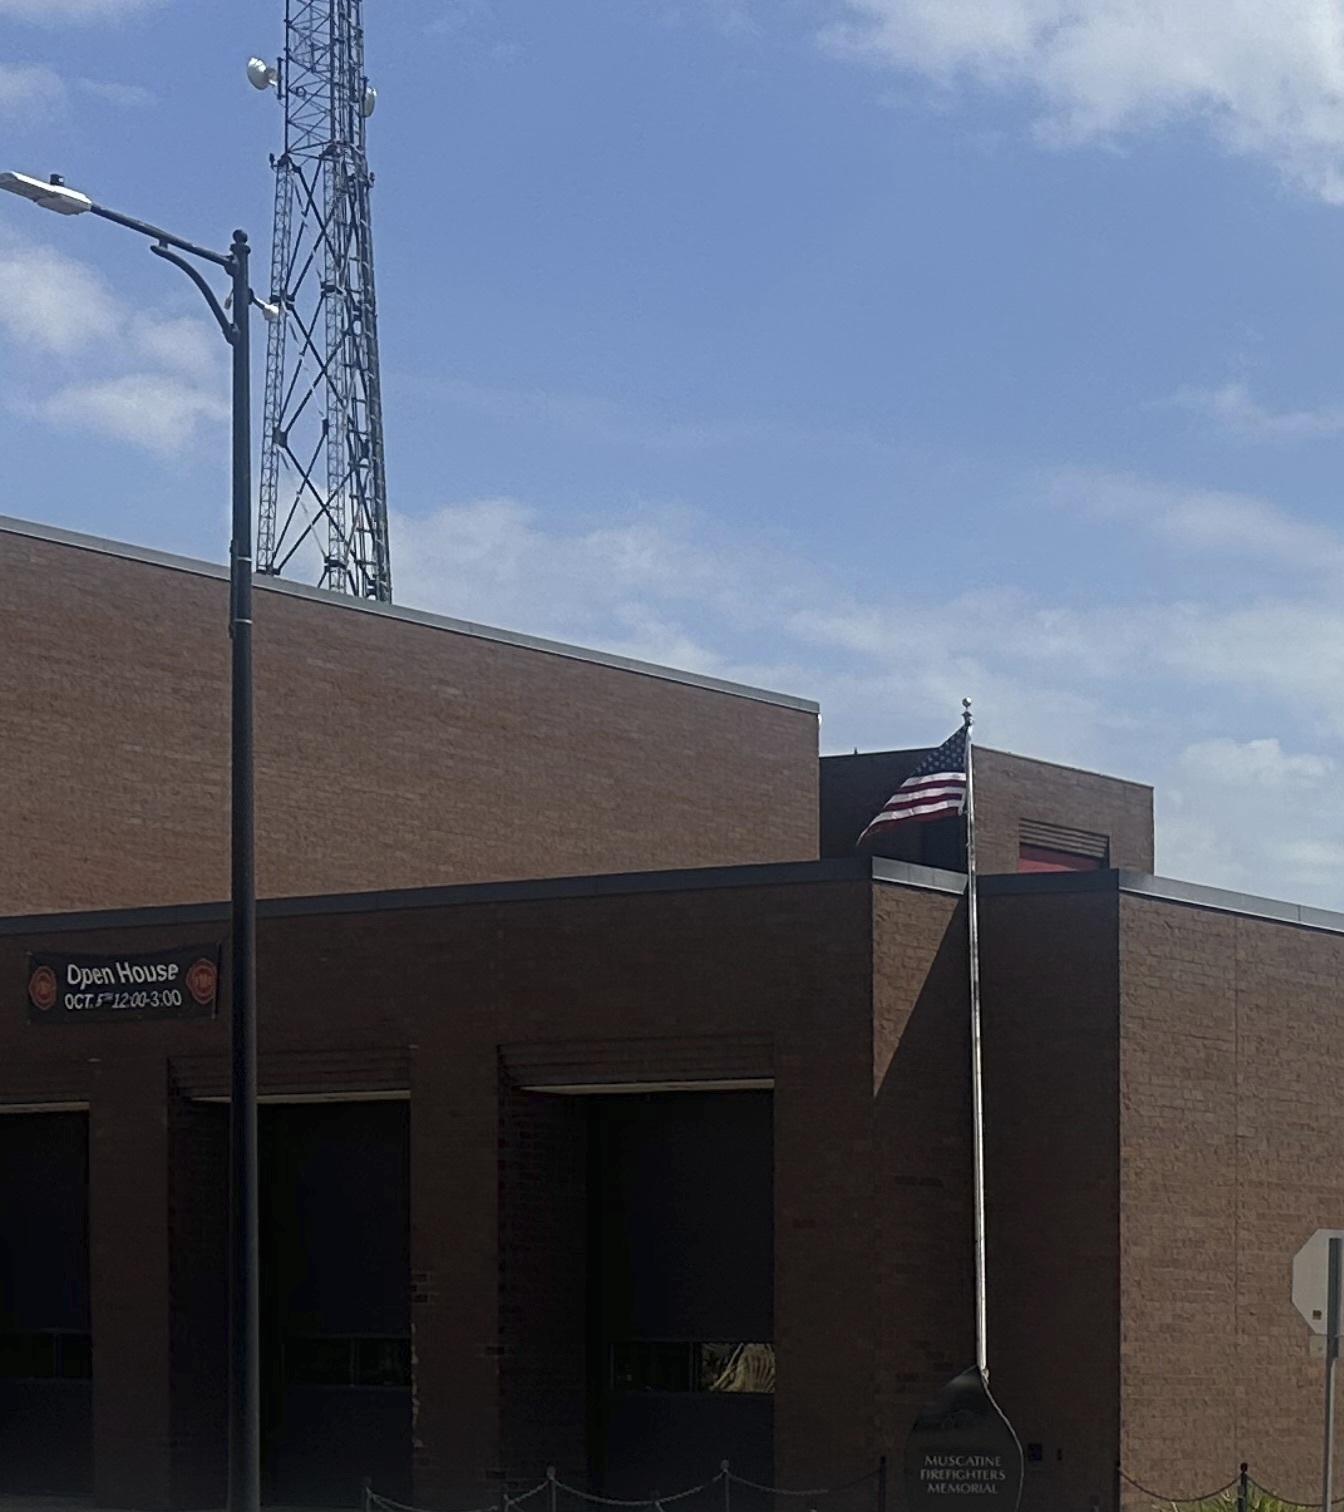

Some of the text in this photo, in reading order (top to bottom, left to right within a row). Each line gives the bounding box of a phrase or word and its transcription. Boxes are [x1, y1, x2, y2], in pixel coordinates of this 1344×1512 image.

[67, 961, 179, 990] Open House
[112, 989, 182, 1010] 12:00-3:00
[924, 1455, 1001, 1467] MUSCATINE
[920, 1469, 1006, 1481] FIREFIGHTERS
[927, 1483, 998, 1494] MEMORIAL
